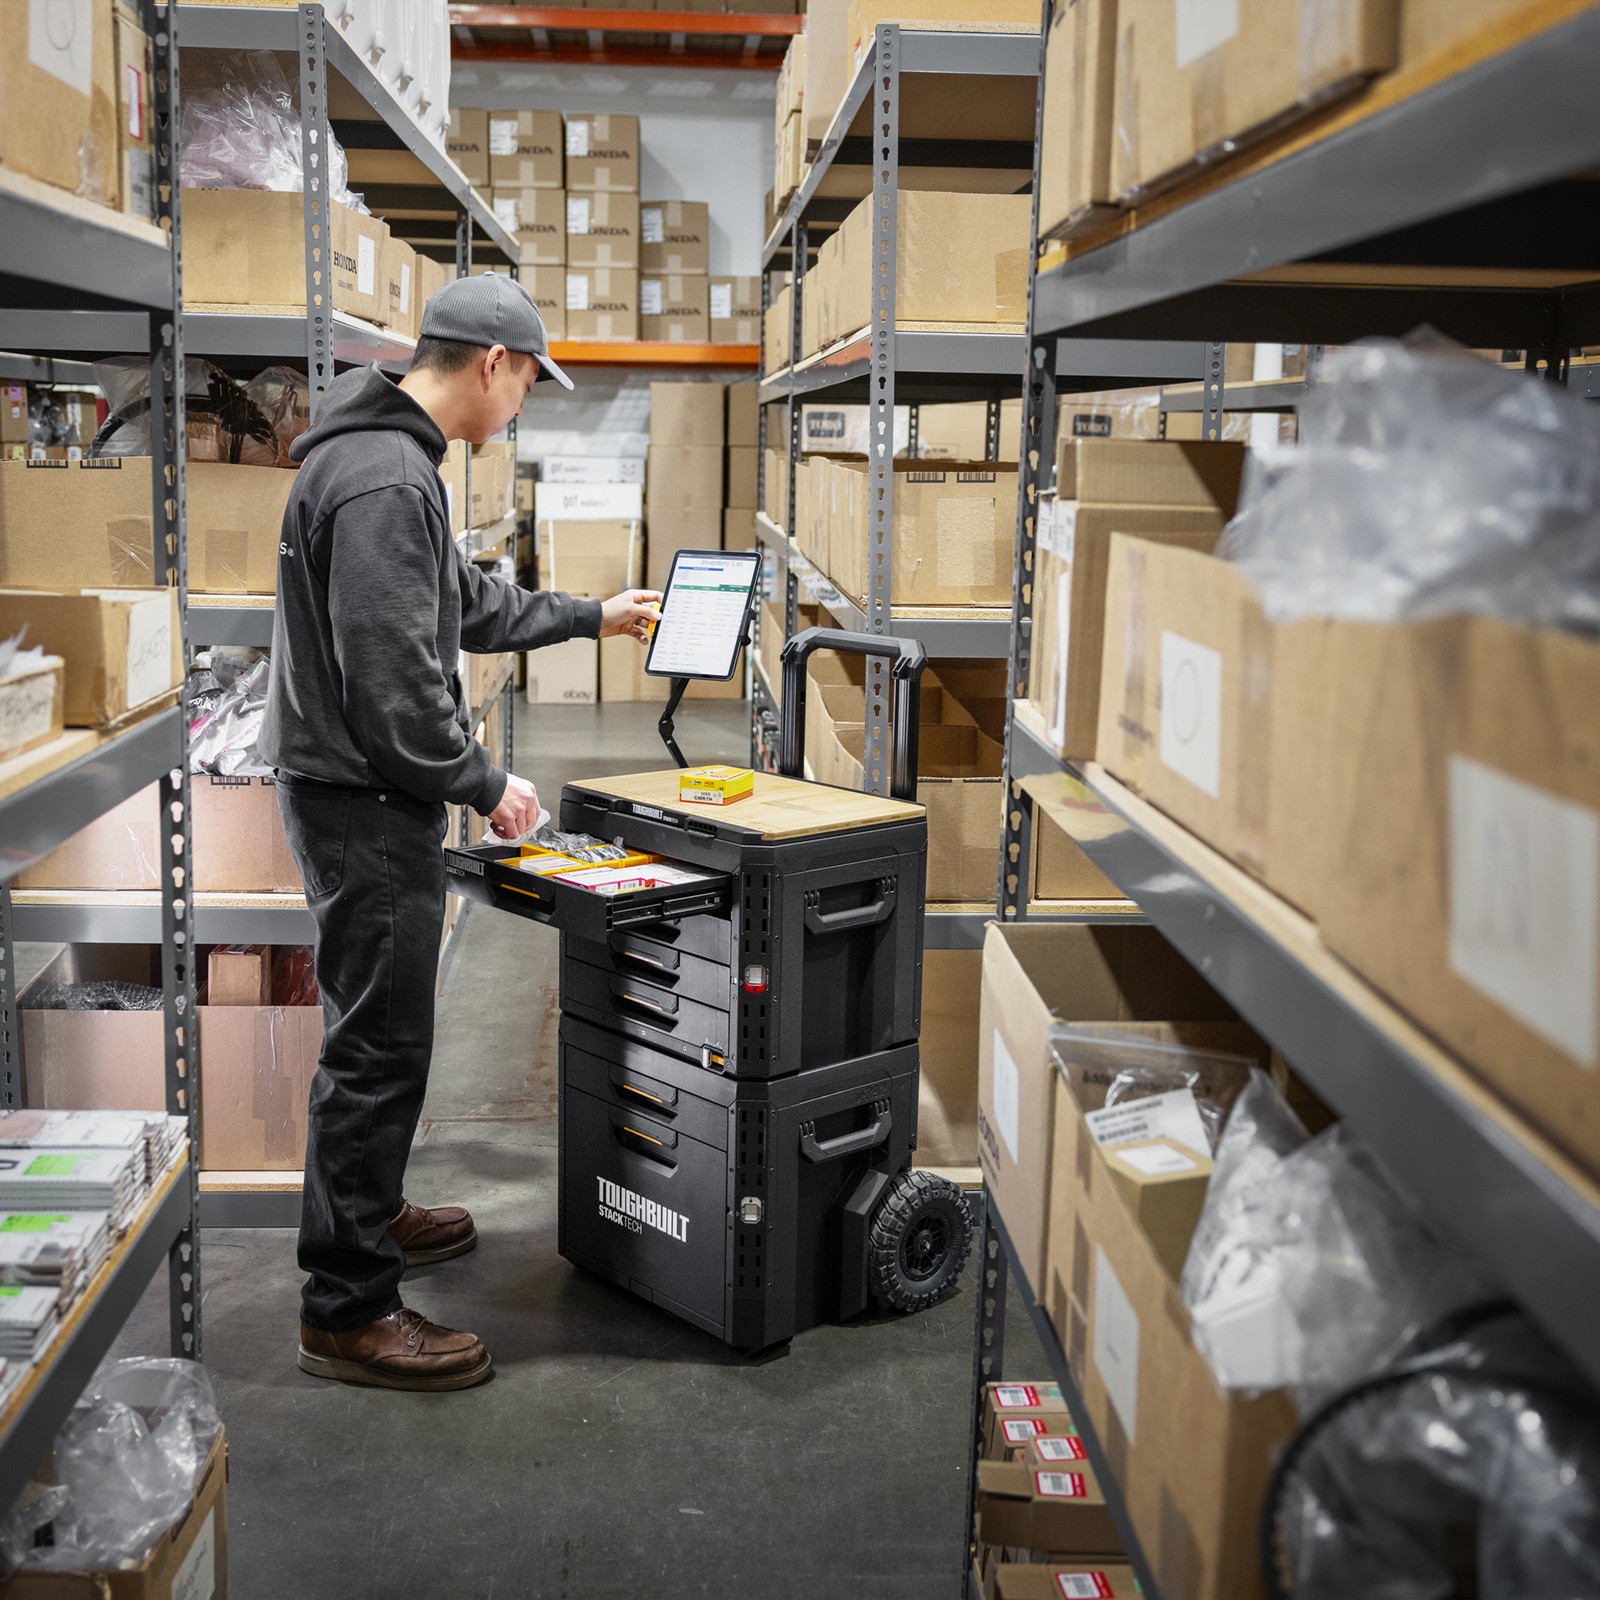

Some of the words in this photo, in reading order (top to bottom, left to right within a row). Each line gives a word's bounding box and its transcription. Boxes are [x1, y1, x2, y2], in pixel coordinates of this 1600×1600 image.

[447, 143, 480, 152] NDA
[517, 145, 553, 155] ONDA
[588, 149, 630, 159] ONDA
[518, 223, 557, 233] ONDA
[589, 226, 630, 236] ONDA
[663, 233, 701, 244] ONDA
[333, 251, 357, 274] HONDA
[587, 301, 629, 312] ONDA
[662, 306, 701, 317] ONDA
[701, 559, 730, 567] Inventory
[563, 688, 592, 701] ebay
[632, 803, 663, 820] TOUGHBUILT
[597, 1175, 690, 1243] TOUGHBUILT
[599, 1204, 643, 1235] STACKTECH
